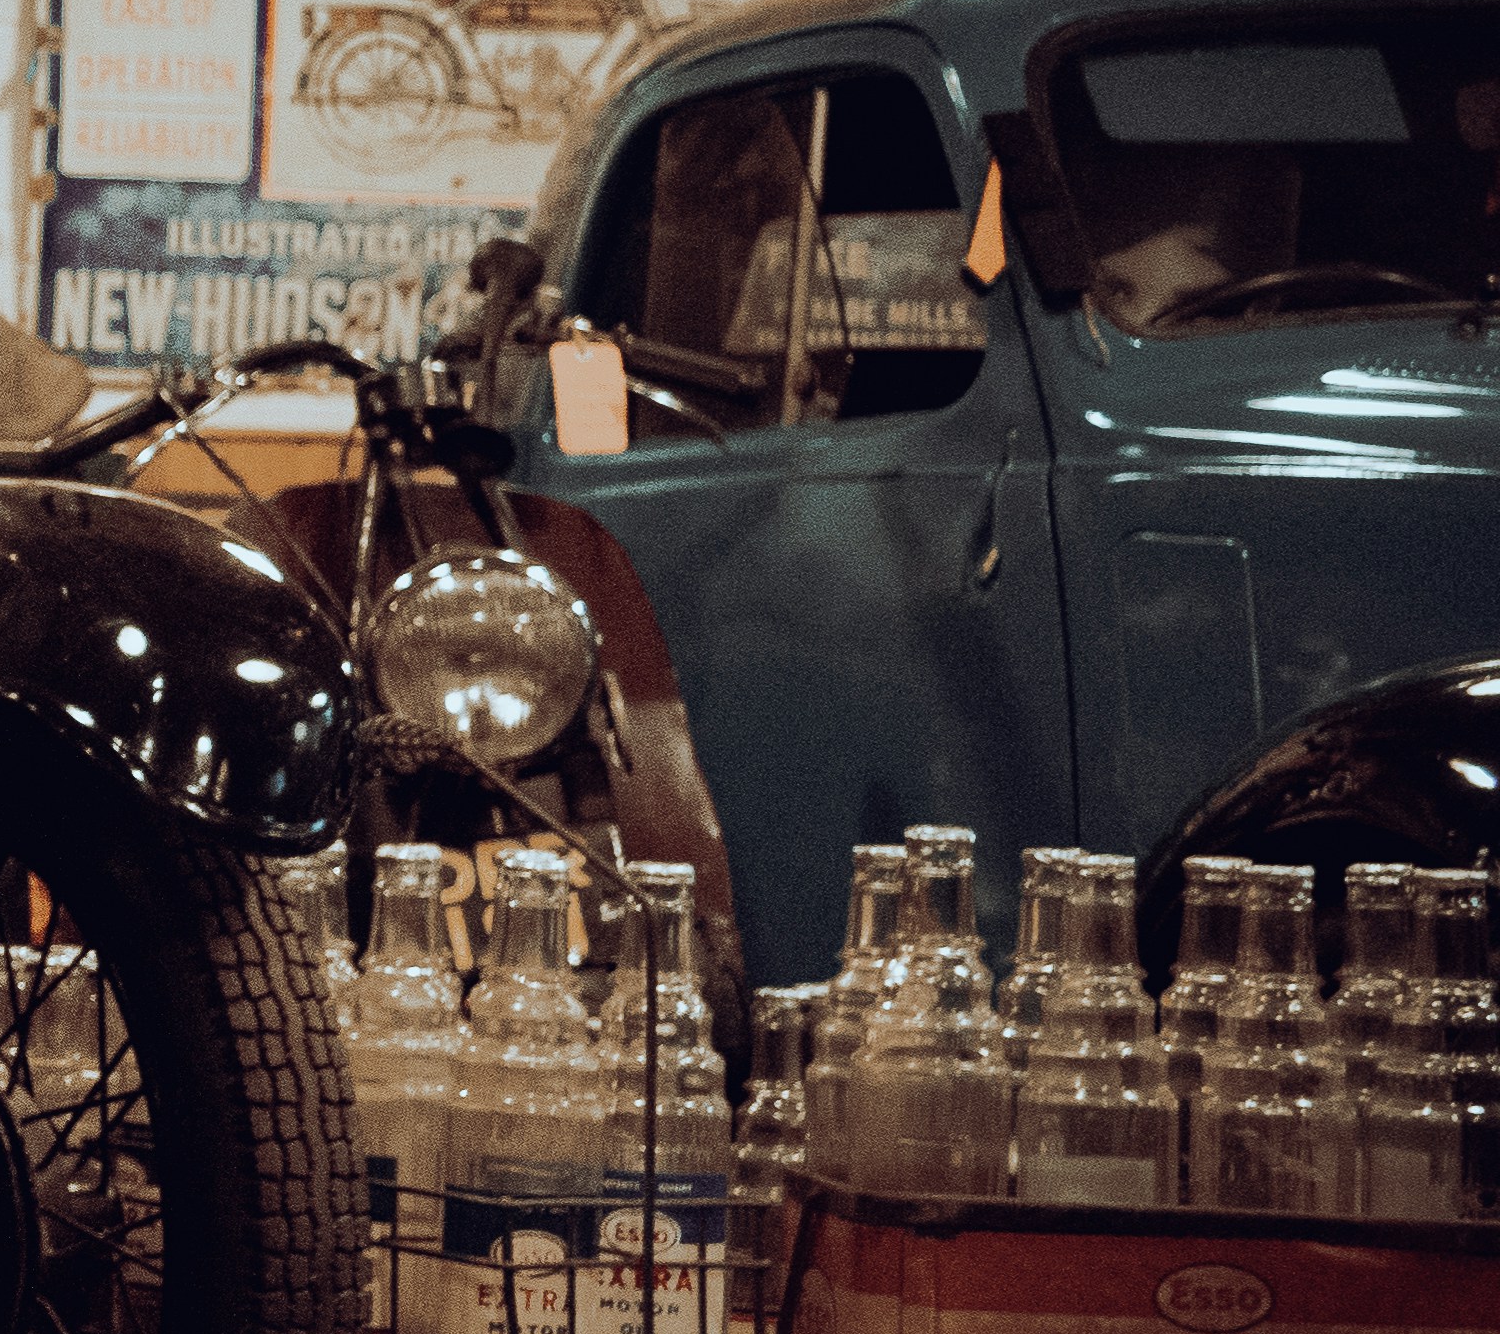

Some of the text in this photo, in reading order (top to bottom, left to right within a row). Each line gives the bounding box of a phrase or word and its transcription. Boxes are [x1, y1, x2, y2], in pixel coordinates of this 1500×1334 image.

[165, 216, 410, 263] ILLUSTRATED
[52, 267, 421, 364] NEW-HUDSON
[613, 1222, 670, 1243] Eso
[1168, 1283, 1263, 1315] Esso
